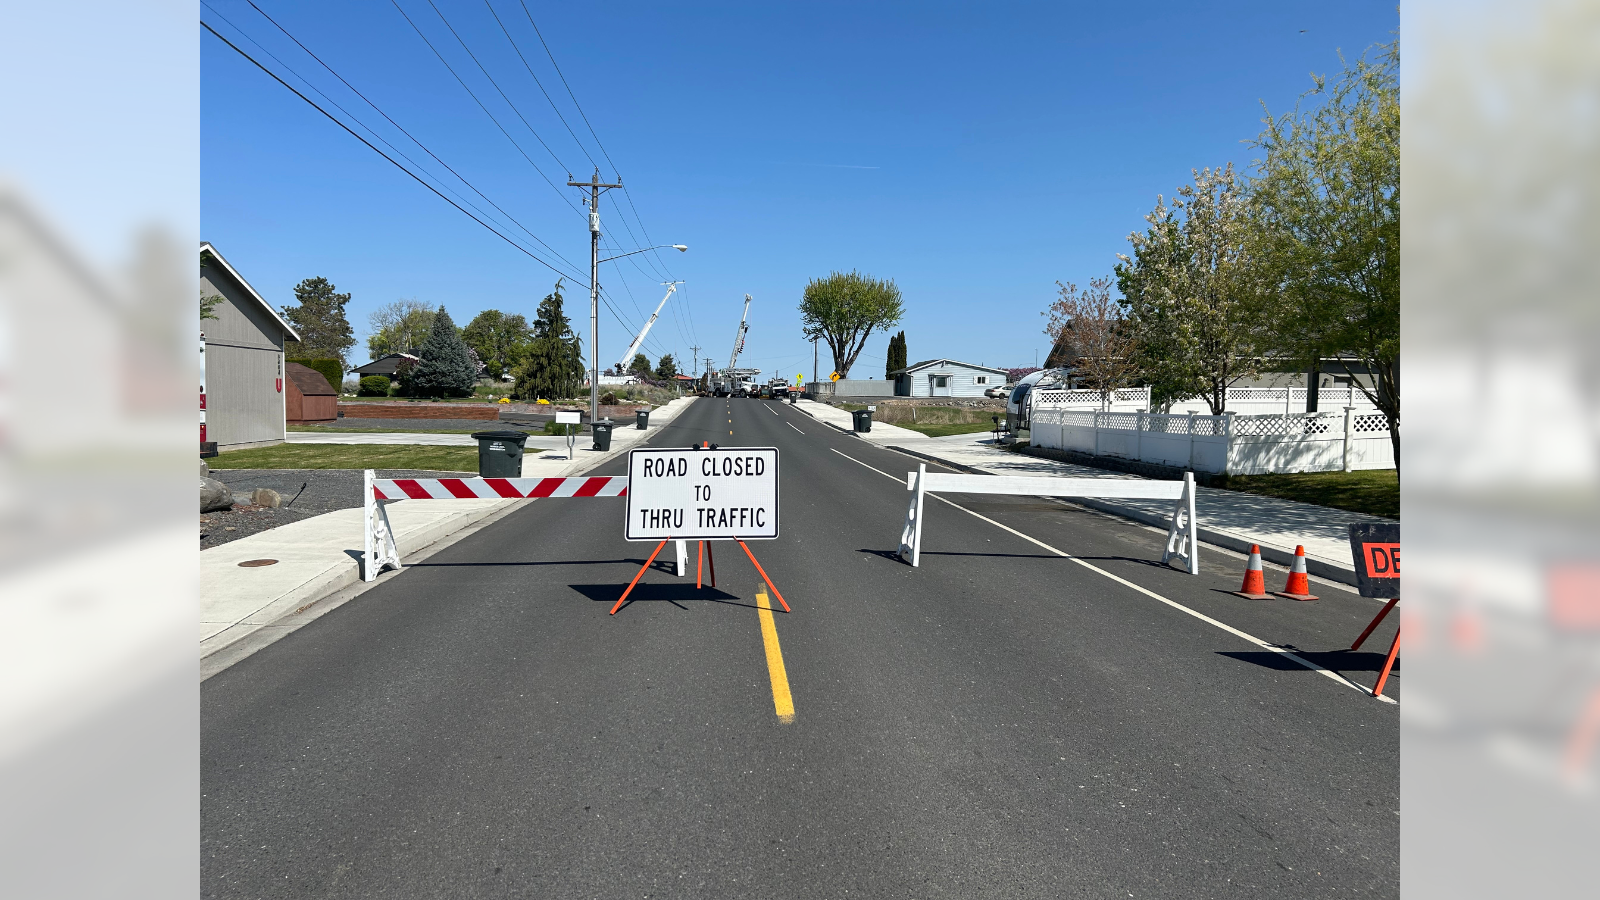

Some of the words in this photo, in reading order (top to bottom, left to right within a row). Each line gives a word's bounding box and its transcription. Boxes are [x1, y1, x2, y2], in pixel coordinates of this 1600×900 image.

[643, 457, 688, 478] ROAD
[701, 456, 765, 477] CLOSED
[694, 484, 711, 502] TO
[640, 508, 684, 529] THRU
[696, 507, 766, 528] TRAFFIC
